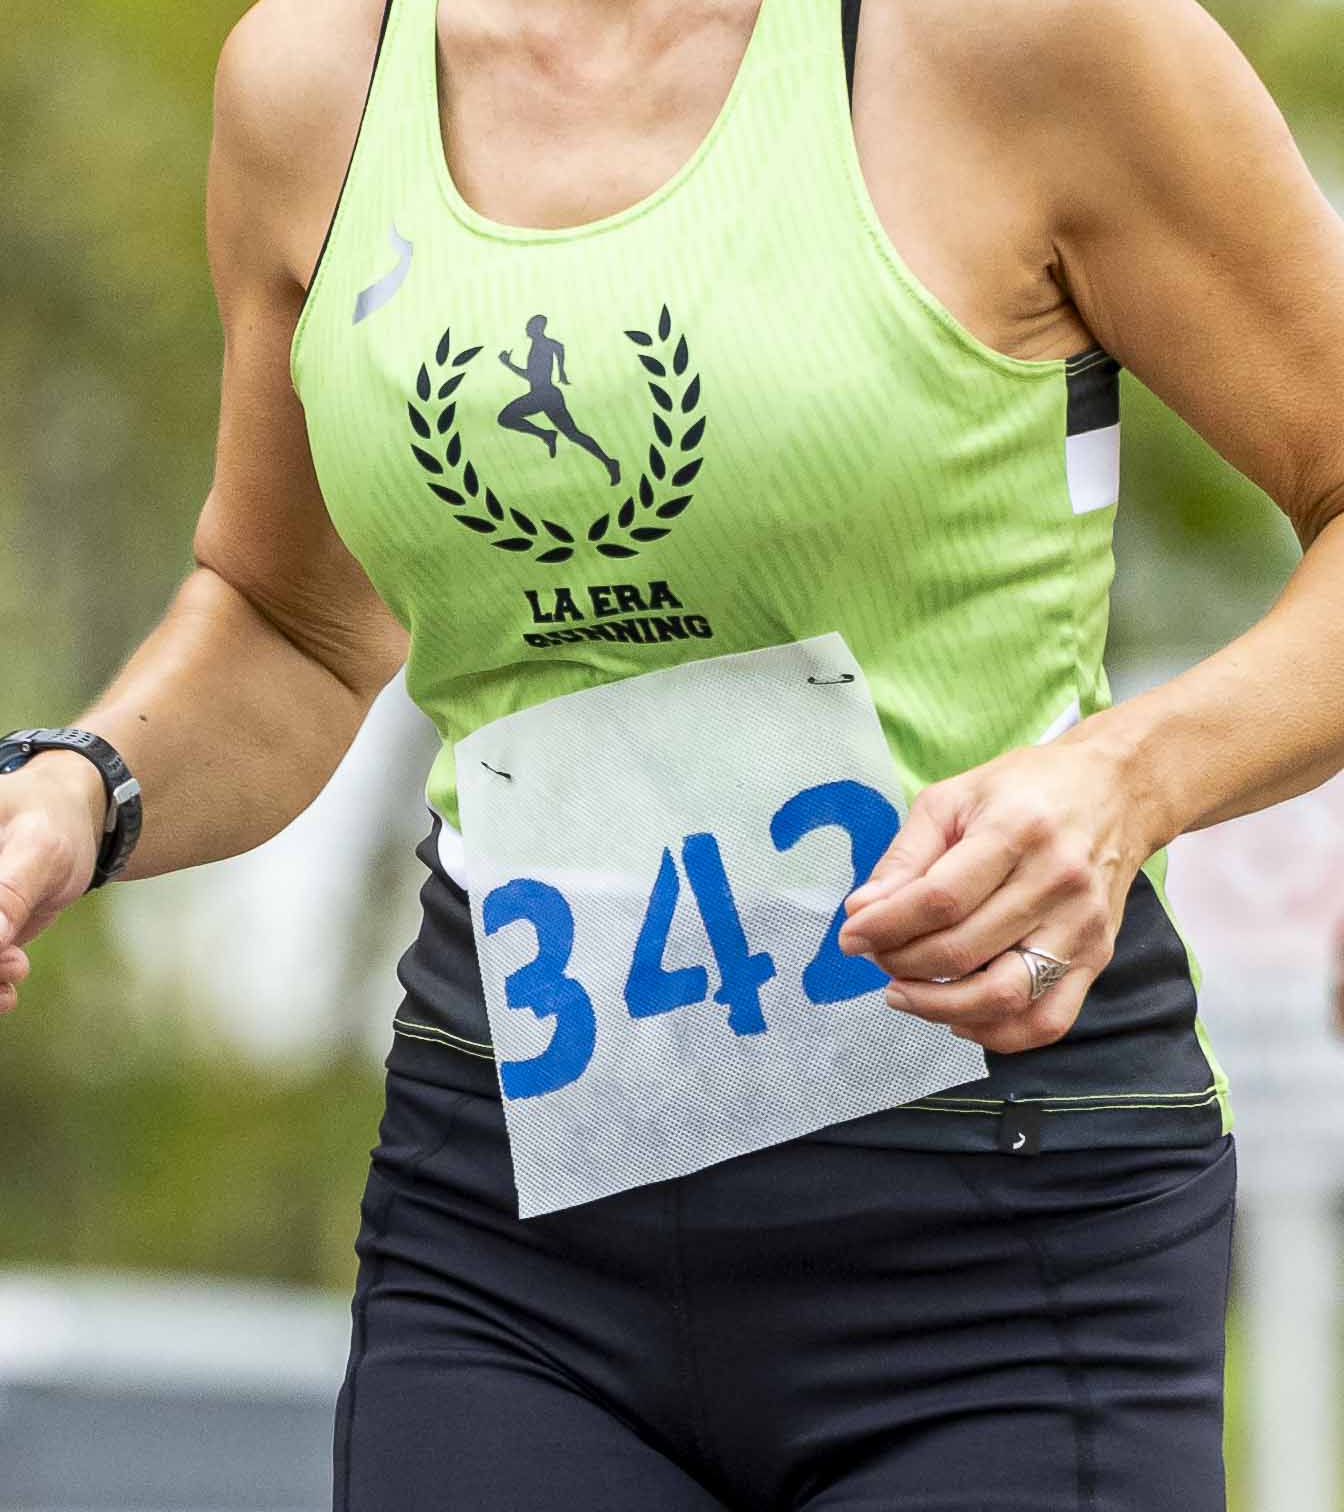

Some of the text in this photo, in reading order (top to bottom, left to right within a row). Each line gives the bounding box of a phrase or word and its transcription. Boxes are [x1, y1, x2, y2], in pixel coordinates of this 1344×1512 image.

[524, 580, 684, 623] LA ERA
[484, 779, 899, 1101] 342
